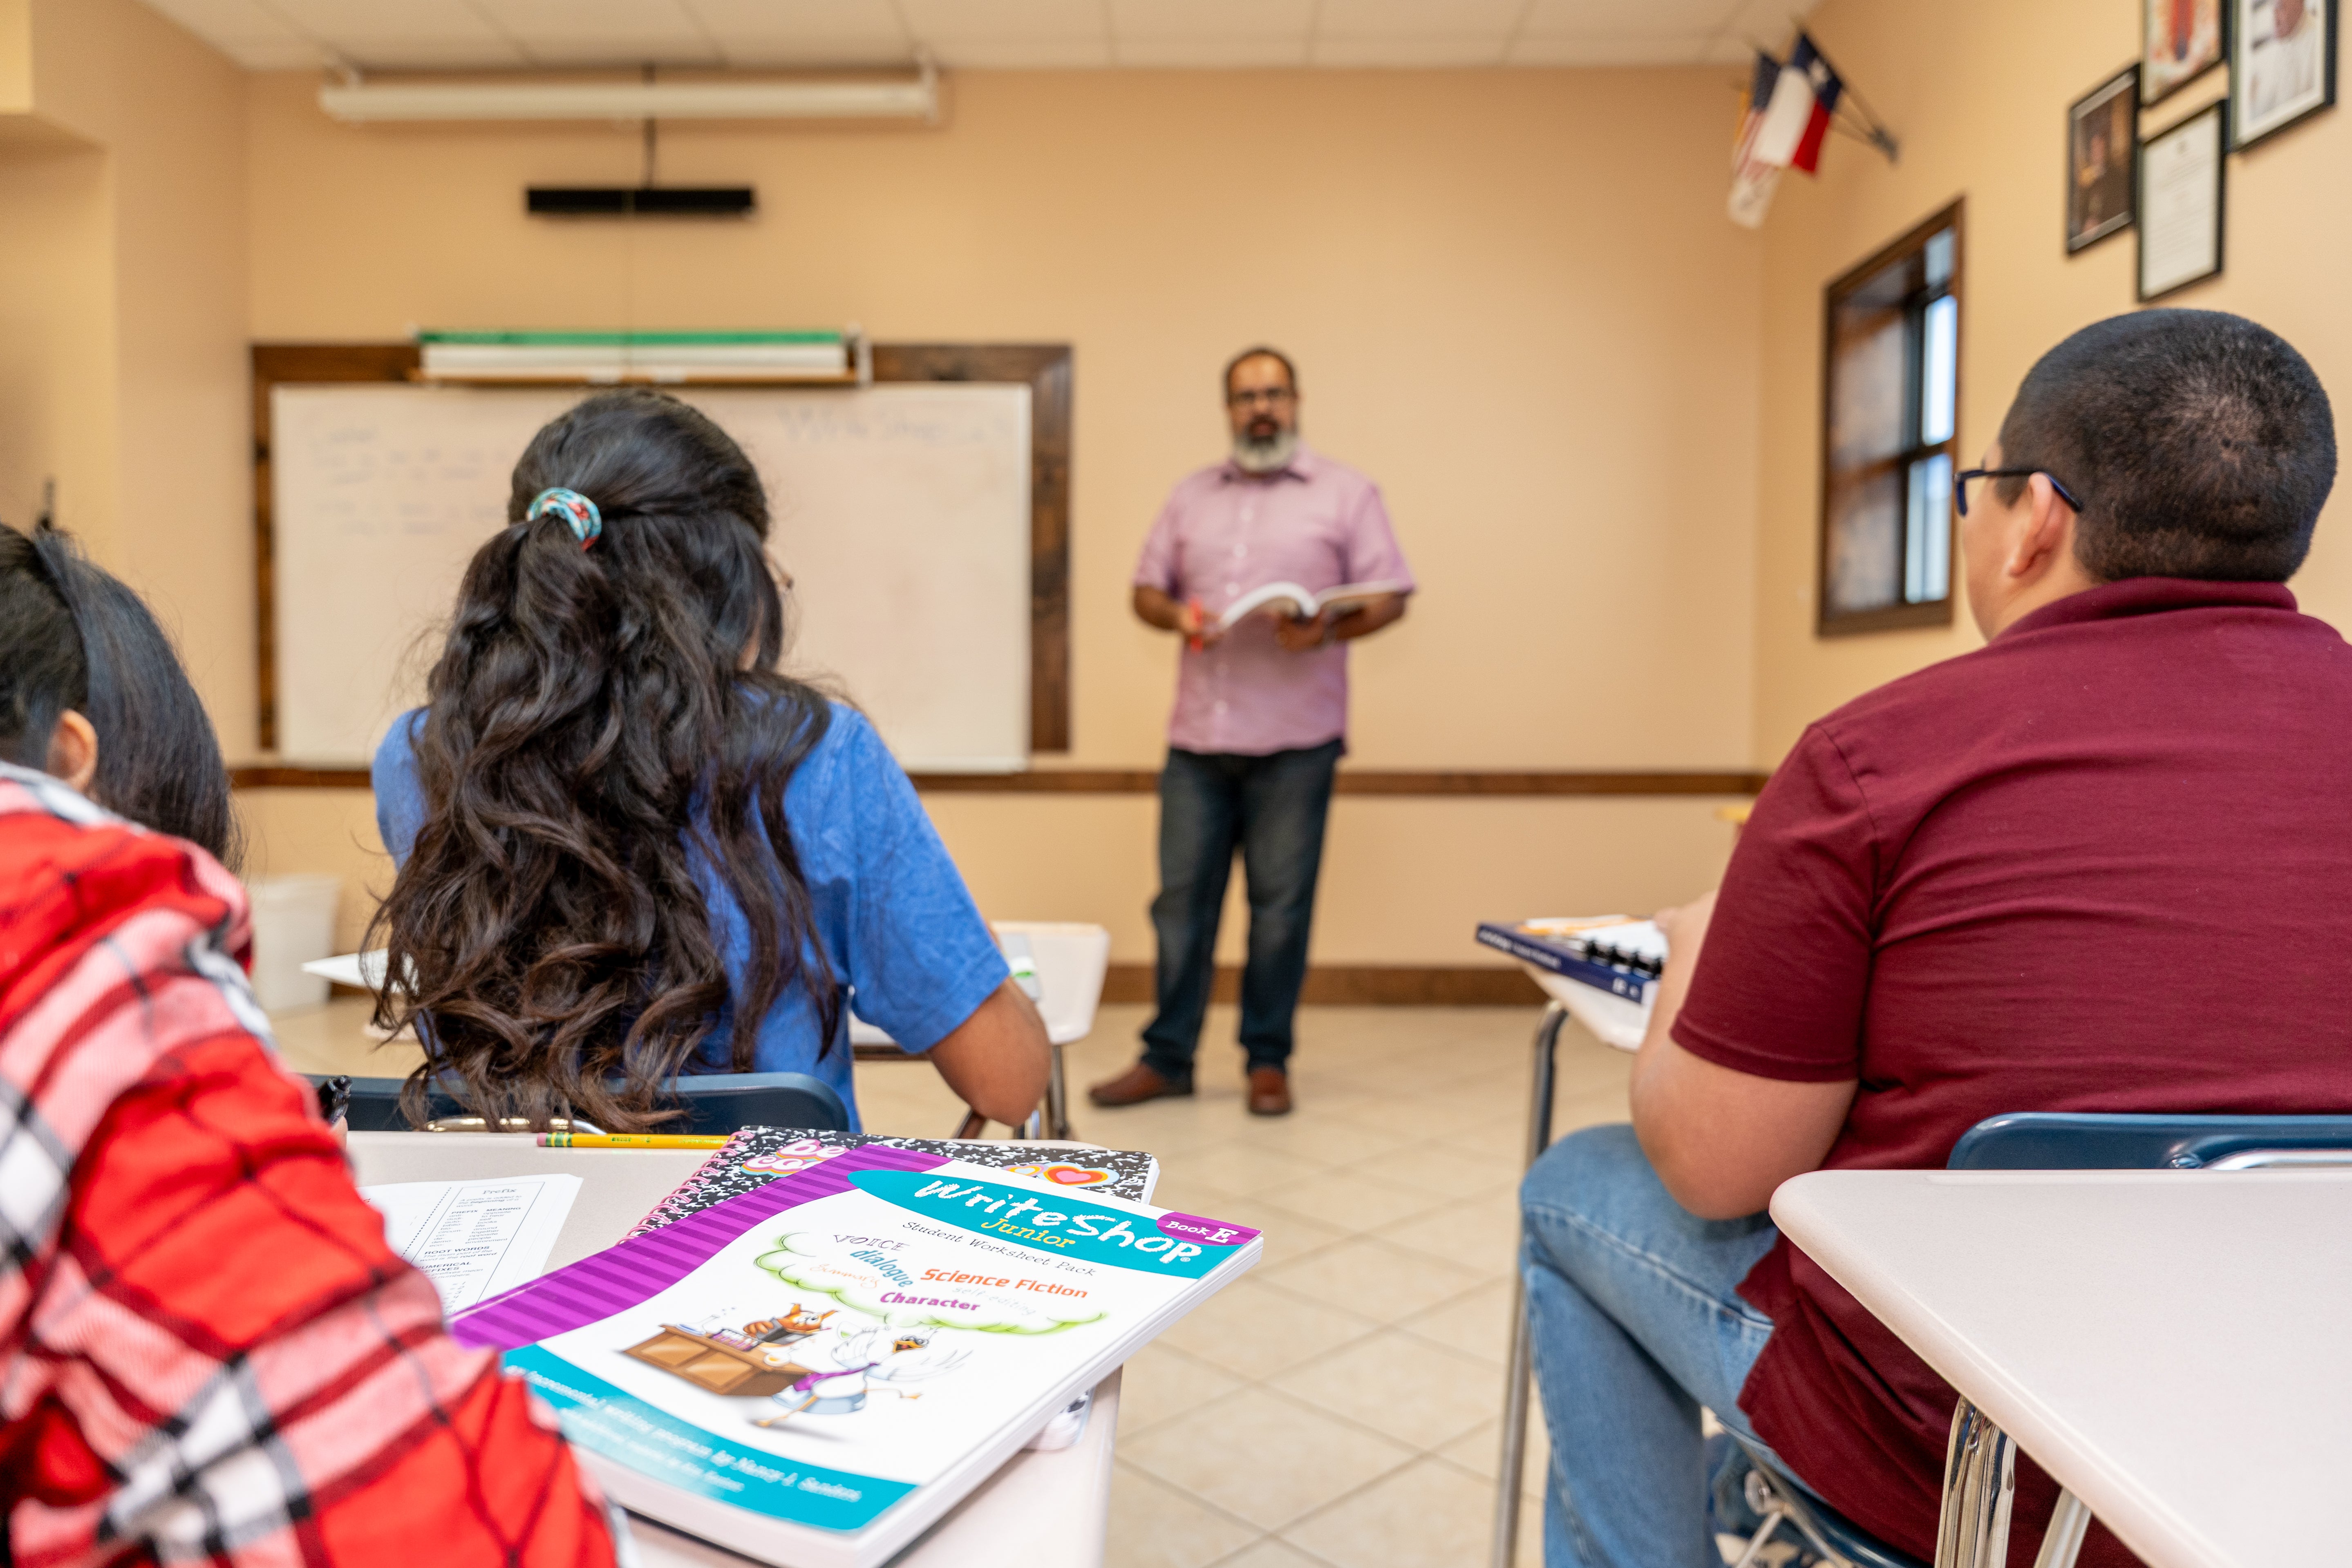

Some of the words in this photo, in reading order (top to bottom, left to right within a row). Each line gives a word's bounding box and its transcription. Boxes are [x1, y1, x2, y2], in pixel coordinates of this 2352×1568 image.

[913, 1180, 1202, 1264] WriteShop
[980, 1218, 1076, 1248] Junior
[1165, 1221, 1210, 1235] Book
[1204, 1227, 1239, 1243] E
[833, 1235, 910, 1251] VOICE
[902, 1221, 963, 1242] Student
[969, 1239, 1051, 1265] Worksheet
[1055, 1262, 1097, 1277] Pack
[416, 1262, 472, 1270] NUMERICAL
[810, 1264, 880, 1288] Summary
[850, 1250, 914, 1287] dialogue
[920, 1268, 1010, 1287] Science
[1015, 1278, 1088, 1298] Fiction
[880, 1292, 981, 1311] Character
